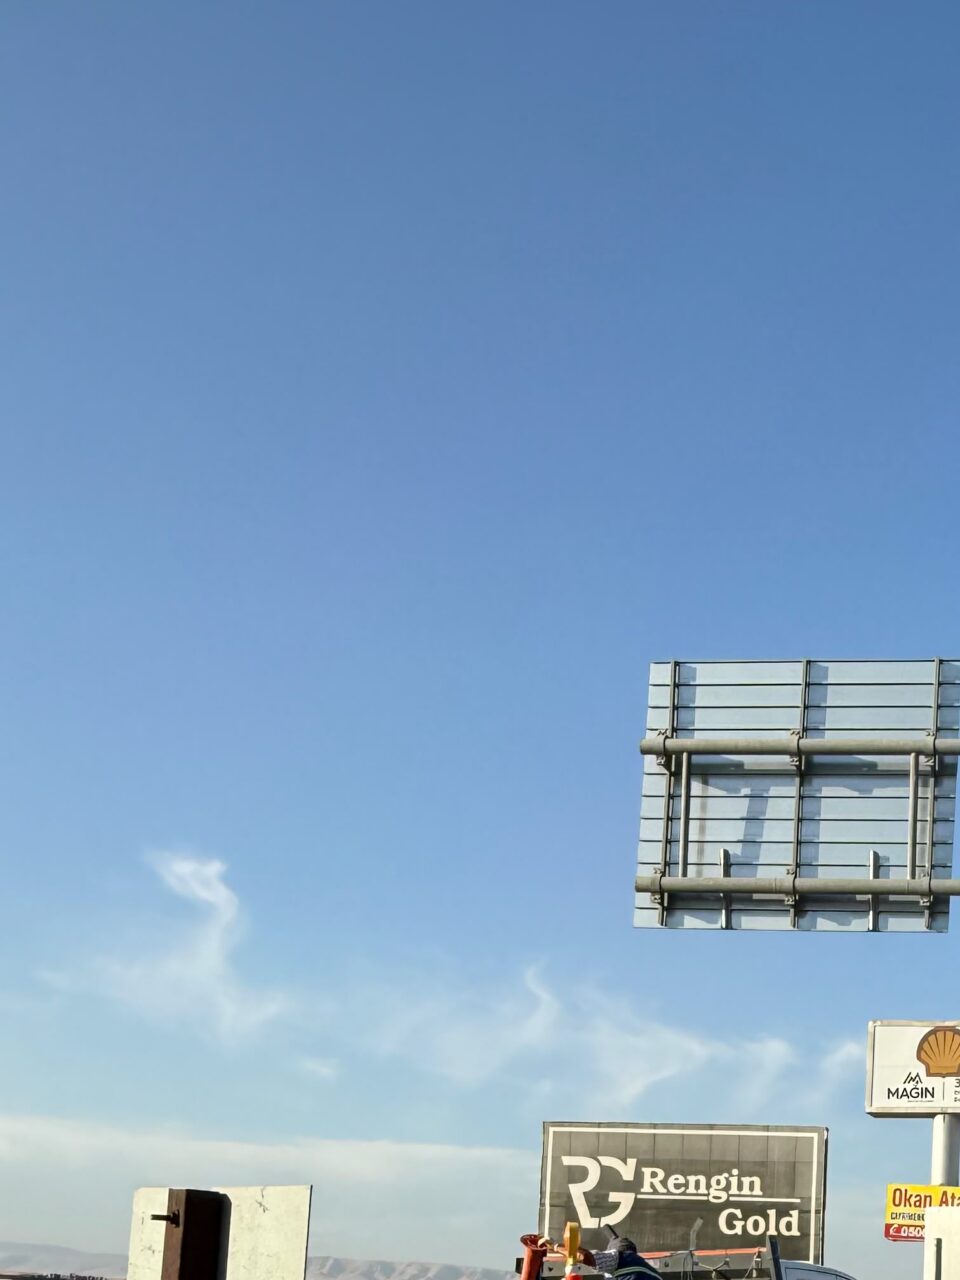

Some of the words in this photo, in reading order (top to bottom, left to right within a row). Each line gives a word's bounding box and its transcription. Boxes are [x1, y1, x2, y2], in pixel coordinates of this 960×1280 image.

[954, 1078, 960, 1088] 3
[641, 1167, 763, 1203] Rengin
[892, 1188, 932, 1208] Okan
[718, 1208, 801, 1236] Gold
